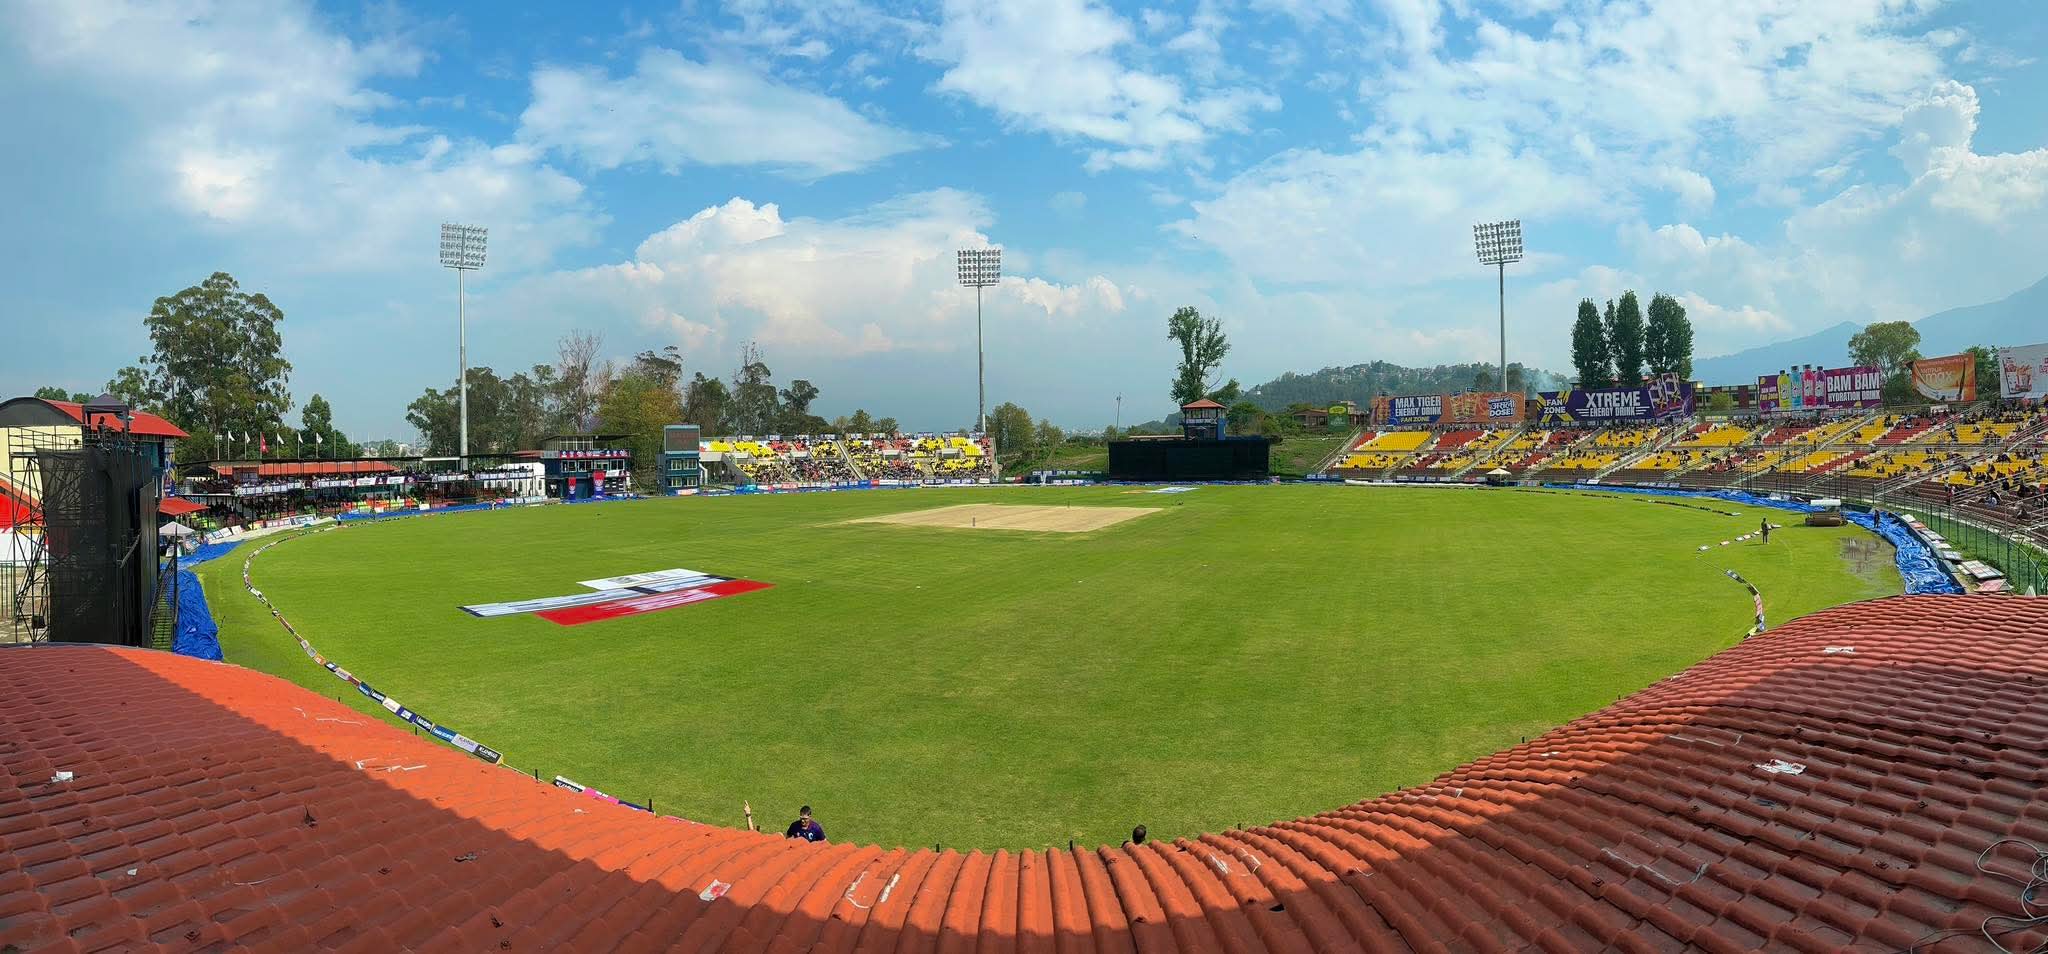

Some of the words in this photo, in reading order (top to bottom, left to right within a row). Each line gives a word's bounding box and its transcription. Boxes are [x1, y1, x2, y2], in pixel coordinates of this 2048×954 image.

[1827, 375, 1851, 392] BAM
[1855, 372, 1880, 390] BAM
[1585, 391, 1641, 408] XTREME
[1828, 391, 1860, 402] HYDRATION
[1862, 388, 1881, 400] DRINK
[1395, 397, 1415, 409] MAX
[1418, 396, 1441, 407] TIGER
[1395, 408, 1420, 417] ENERGY
[1421, 406, 1442, 415] DRINK
[1489, 408, 1513, 417] DOSE!
[1544, 406, 1566, 414] ZONE
[1589, 407, 1614, 416] ENERGY
[1615, 406, 1636, 415] DRINK
